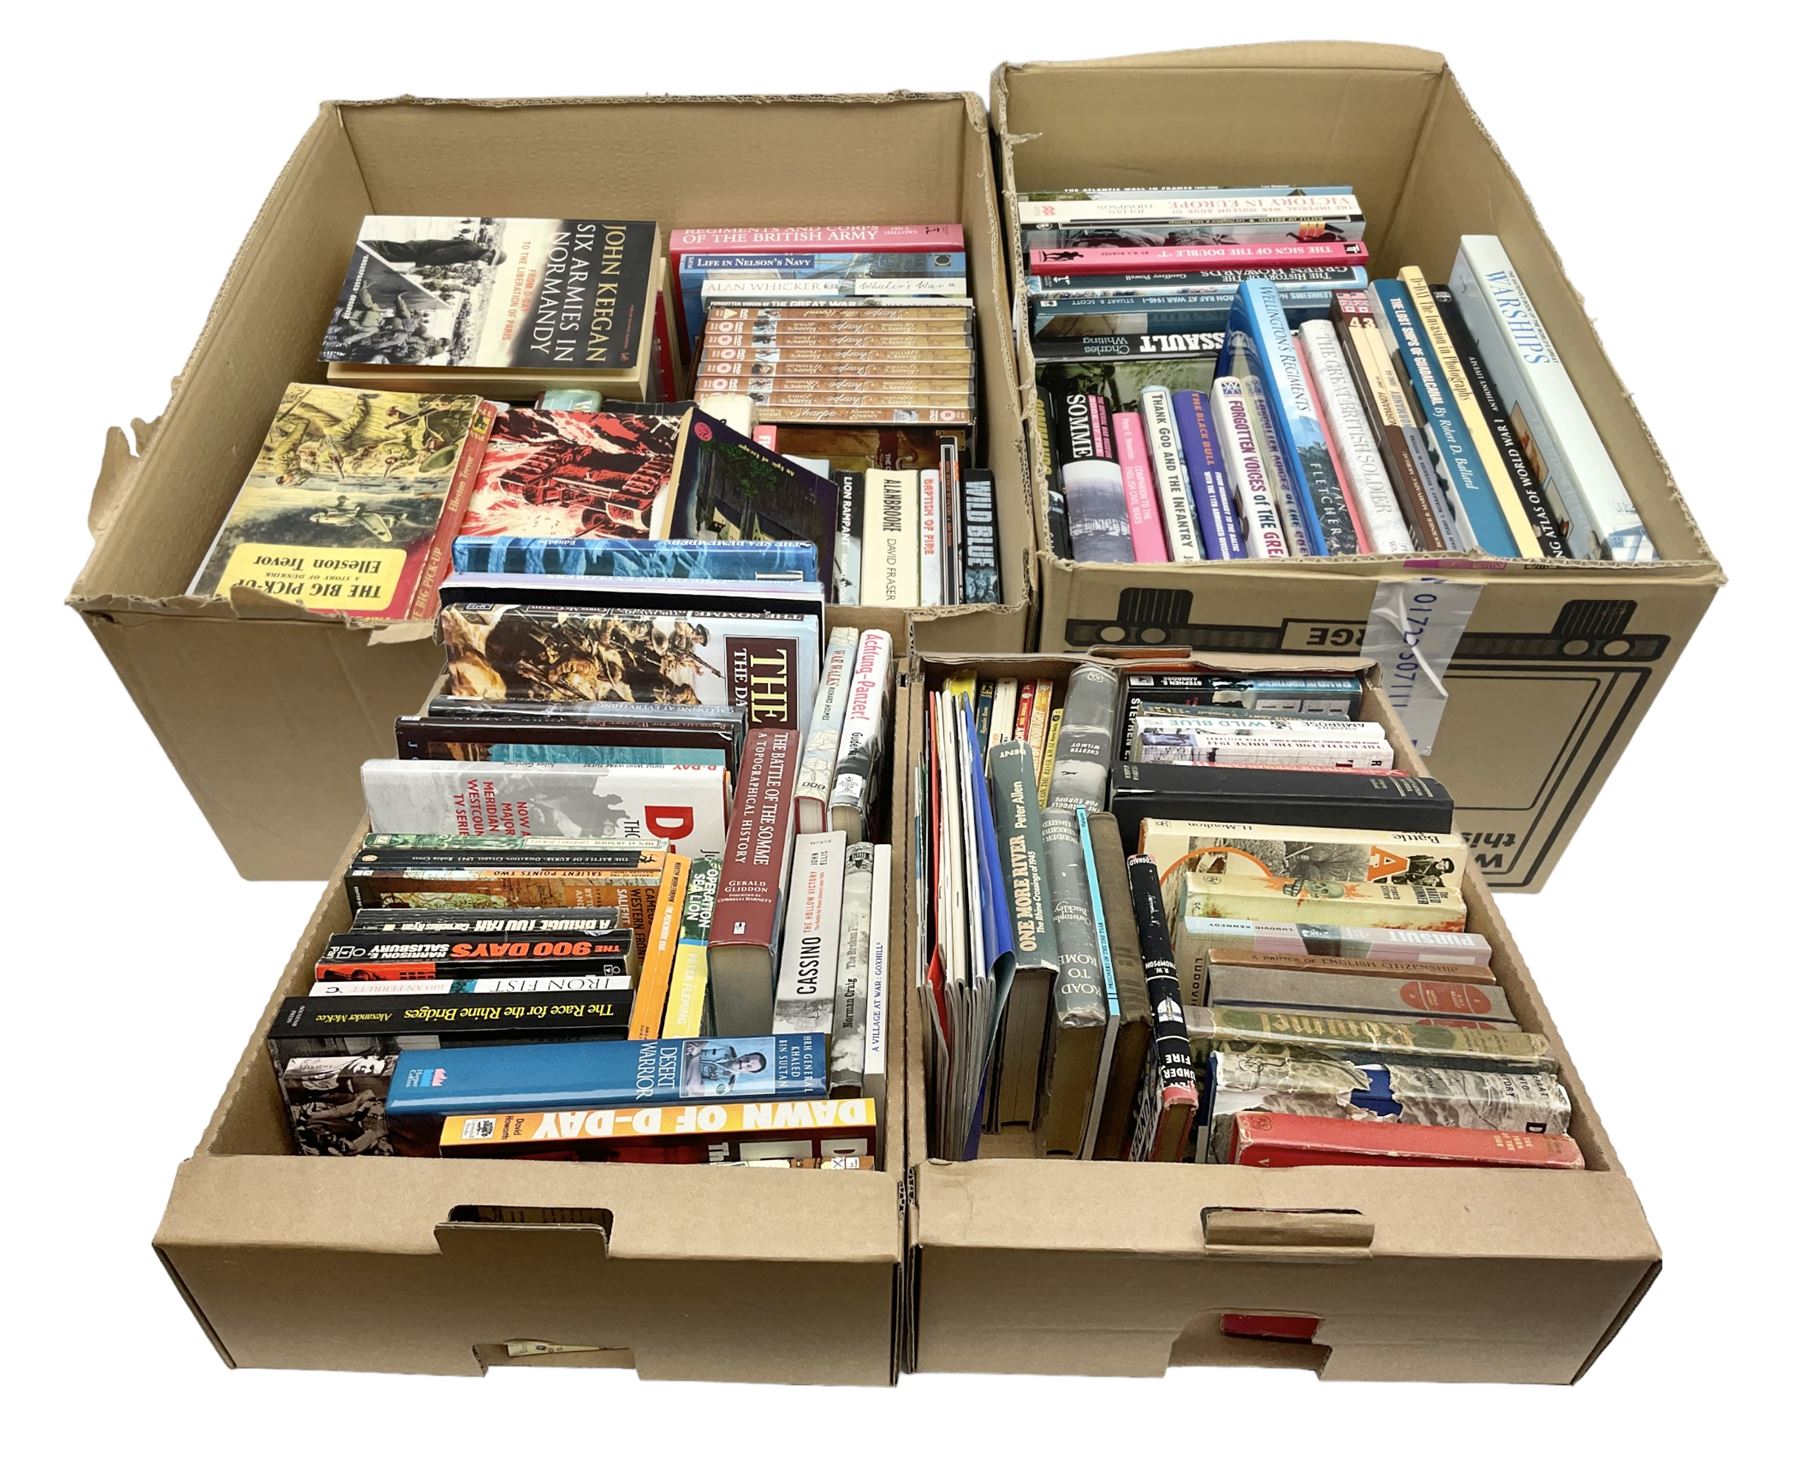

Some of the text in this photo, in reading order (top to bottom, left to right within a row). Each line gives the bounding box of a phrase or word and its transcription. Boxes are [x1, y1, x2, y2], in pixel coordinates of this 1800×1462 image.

[682, 233, 703, 244] OF
[710, 232, 747, 243] THE
[753, 231, 822, 242] BRITISH
[828, 229, 879, 241] ARMY
[1178, 246, 1332, 257] THE SIGN OF THE DOUBLE
[706, 281, 821, 292] ALAN WHICKER
[720, 258, 732, 266] IN
[1125, 273, 1186, 281] Geoffrey Powell
[502, 252, 529, 341] THE LIBERATION PARIS
[530, 232, 571, 355] NORMANDY
[553, 223, 596, 362] SIX ARMIES IN
[585, 224, 626, 363] JOHN KEEGAN
[1421, 301, 1432, 314] The
[1083, 337, 1128, 346] Whiting
[1426, 316, 1447, 347] Invasion
[1485, 271, 1549, 365] WARSHIPS
[1084, 344, 1129, 355] Charles
[1259, 287, 1310, 411] WELLINGTON'S REGIMENTS
[1390, 298, 1478, 490] THE LOST SHIPS GUADALCANAL By Robert D. Ballard
[1443, 356, 1470, 400] Photographs
[1066, 394, 1092, 459] SOMME
[1192, 393, 1214, 465] THE BLACK BULL
[1317, 335, 1392, 514] THE GREAT BRITISH SOLDIER
[842, 476, 852, 496] LION
[1152, 395, 1193, 548] THANK GOD AND THE INFANTRY
[1229, 401, 1275, 528] FORGOTTEN of THE
[1497, 426, 1556, 539] ATLAS OF WORLD WAR
[842, 496, 852, 548] RAMPANT
[924, 478, 935, 556] BAPTISM OF FIRE
[1310, 463, 1342, 535] FLETCHER
[883, 478, 902, 602] ALANBROOKE DAVID FRASER
[965, 481, 995, 568] WILD BLUE
[254, 556, 382, 574] Elleston Trevor
[418, 548, 442, 610] BIG PICK-UP
[309, 584, 382, 598] THE BIG
[751, 650, 788, 722] THE
[850, 633, 884, 721] Achtung-Panzer!
[1125, 698, 1141, 747] STEPHEN
[1168, 718, 1265, 728] WILD BLUE
[483, 781, 499, 832] MERIDIAN
[501, 803, 514, 836] MAJOR
[735, 741, 766, 864] TOPOGRAPHICAL HISTORY
[754, 732, 789, 865] THE BATTLE OF THE SOMME
[1011, 780, 1027, 829] Peter Allen
[1464, 833, 1516, 850] this
[687, 892, 700, 920] LION
[698, 867, 719, 928] OPERATION
[805, 870, 817, 915] HOLLOW VICTORY
[1008, 835, 1037, 951] ONE MORE RIVER
[1028, 850, 1046, 933] The Rhine Crossings 1945
[372, 944, 449, 952] SALISBURY
[451, 941, 621, 958] THE 900 DAYS
[1057, 954, 1097, 965] ROME
[1388, 930, 1476, 947] PURSUIT
[495, 977, 610, 992] IRON FIST
[677, 951, 697, 1025] PETER FLEMING
[796, 937, 821, 995] CASSINO
[1067, 967, 1091, 979] TO
[316, 1011, 393, 1022] Alexander McKee
[404, 1003, 614, 1021] The Race for the Rhine Bridges
[842, 978, 858, 1029] Norman Craig
[873, 1011, 881, 1044] VILLAGE
[874, 1000, 882, 1010] AT
[636, 1041, 656, 1100] WARRIOR
[658, 1046, 678, 1089] DESERT
[778, 1040, 788, 1088] BIN SULTAN
[791, 1045, 800, 1079] KHALED
[803, 1035, 814, 1093] HRH GENERAL
[1165, 1054, 1191, 1064] FIRE
[531, 1100, 867, 1140] DAWN OF D-DAY
